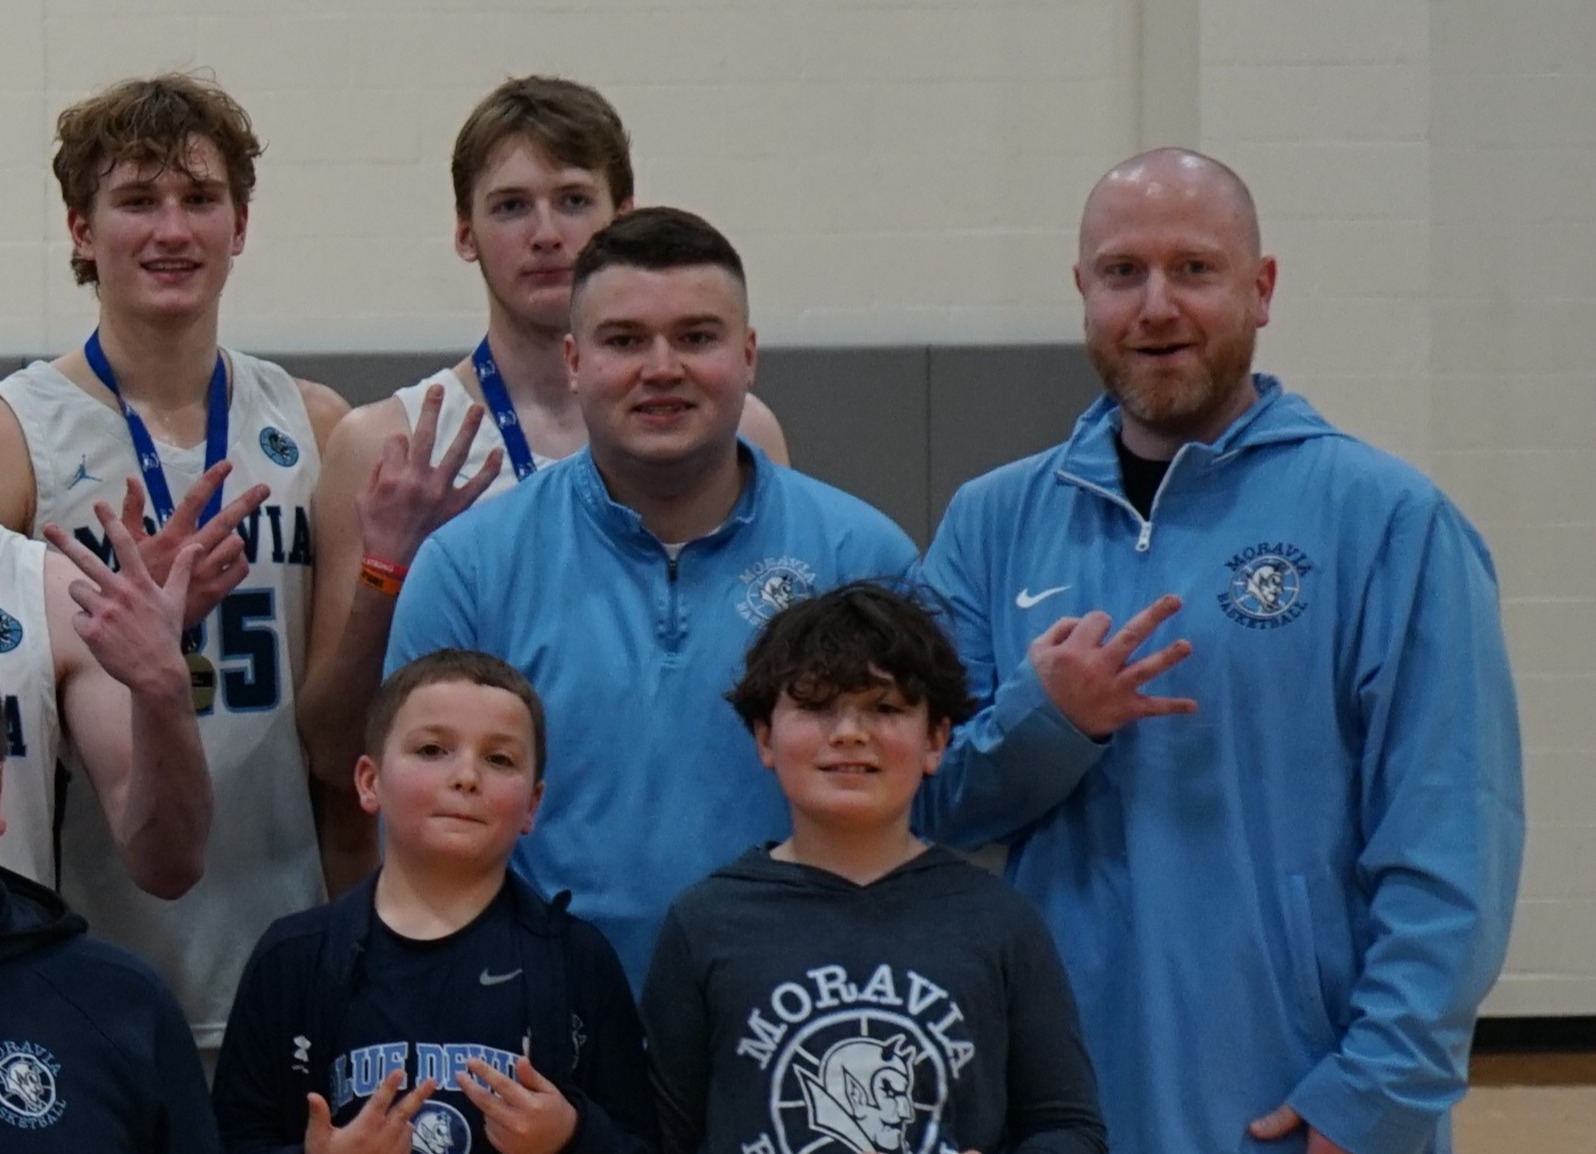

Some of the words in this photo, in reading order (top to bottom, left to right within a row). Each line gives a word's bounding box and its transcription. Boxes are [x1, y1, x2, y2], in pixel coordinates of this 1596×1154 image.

[1224, 542, 1312, 577] MORAVIA
[1216, 591, 1309, 630] BASKETBALL
[179, 587, 280, 715] 5
[736, 963, 976, 1079] MORAVIA
